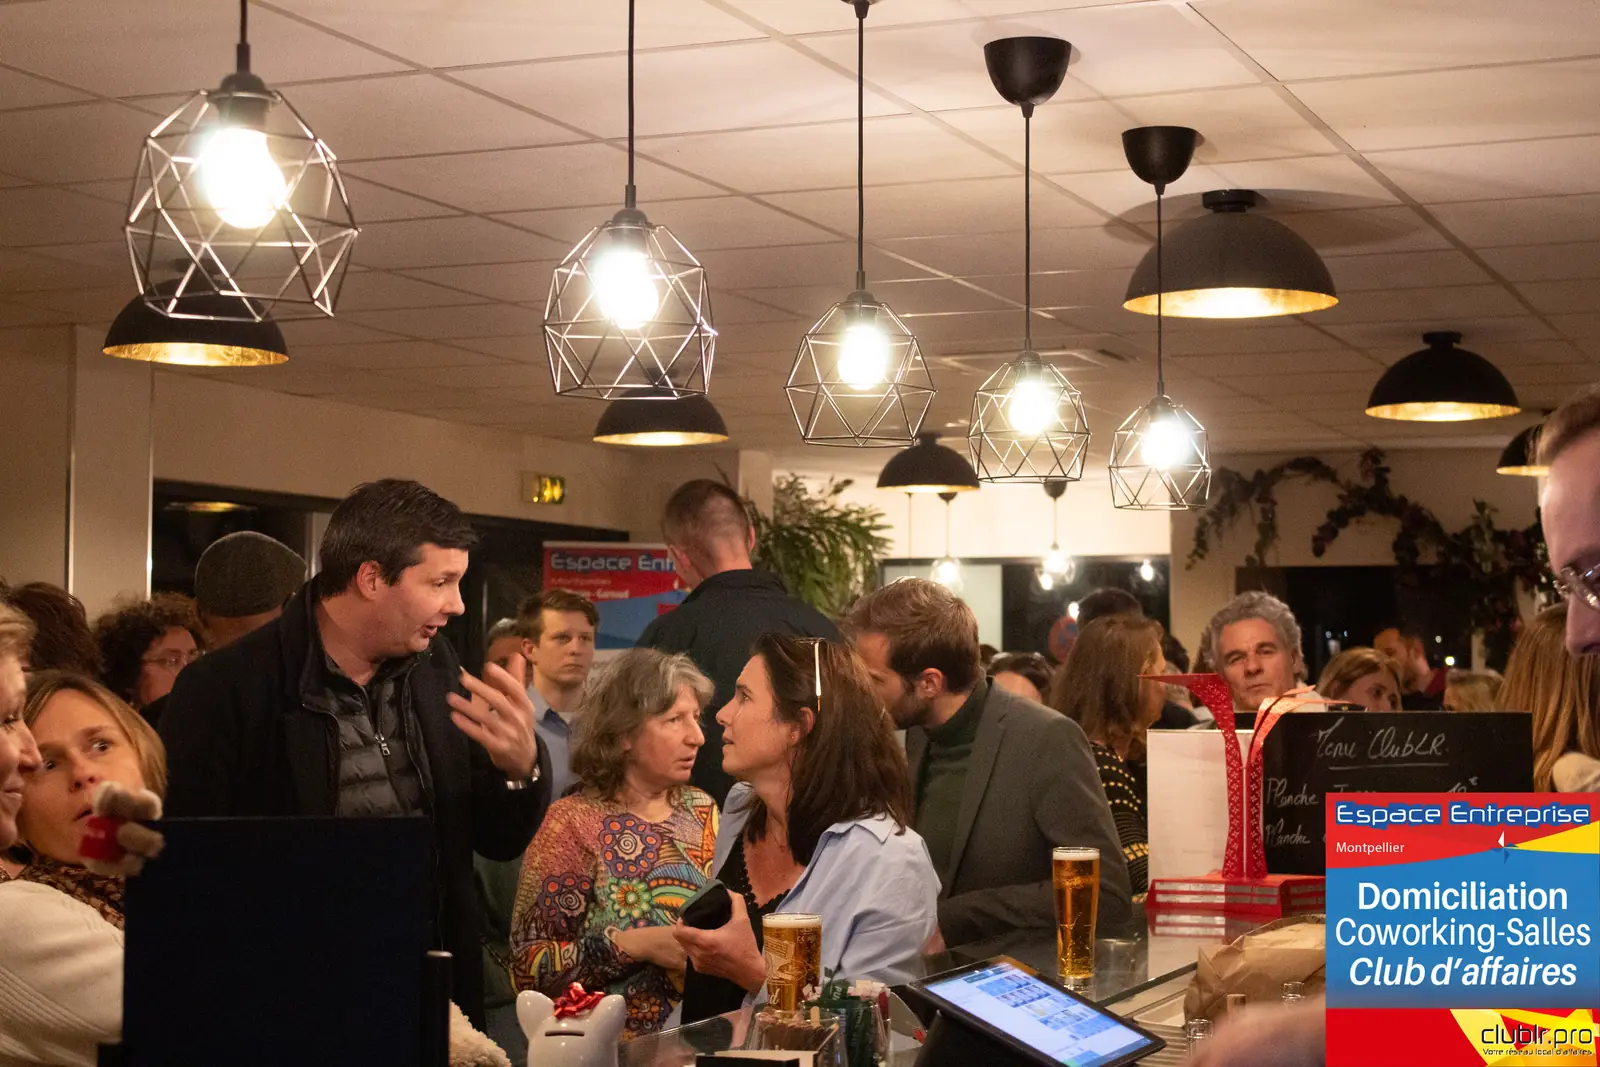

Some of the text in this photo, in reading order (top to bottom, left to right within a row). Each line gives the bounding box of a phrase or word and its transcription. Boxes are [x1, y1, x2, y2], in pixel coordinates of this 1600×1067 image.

[551, 553, 631, 573] Espace
[1267, 778, 1319, 807] Planche
[1265, 818, 1311, 846] Planche
